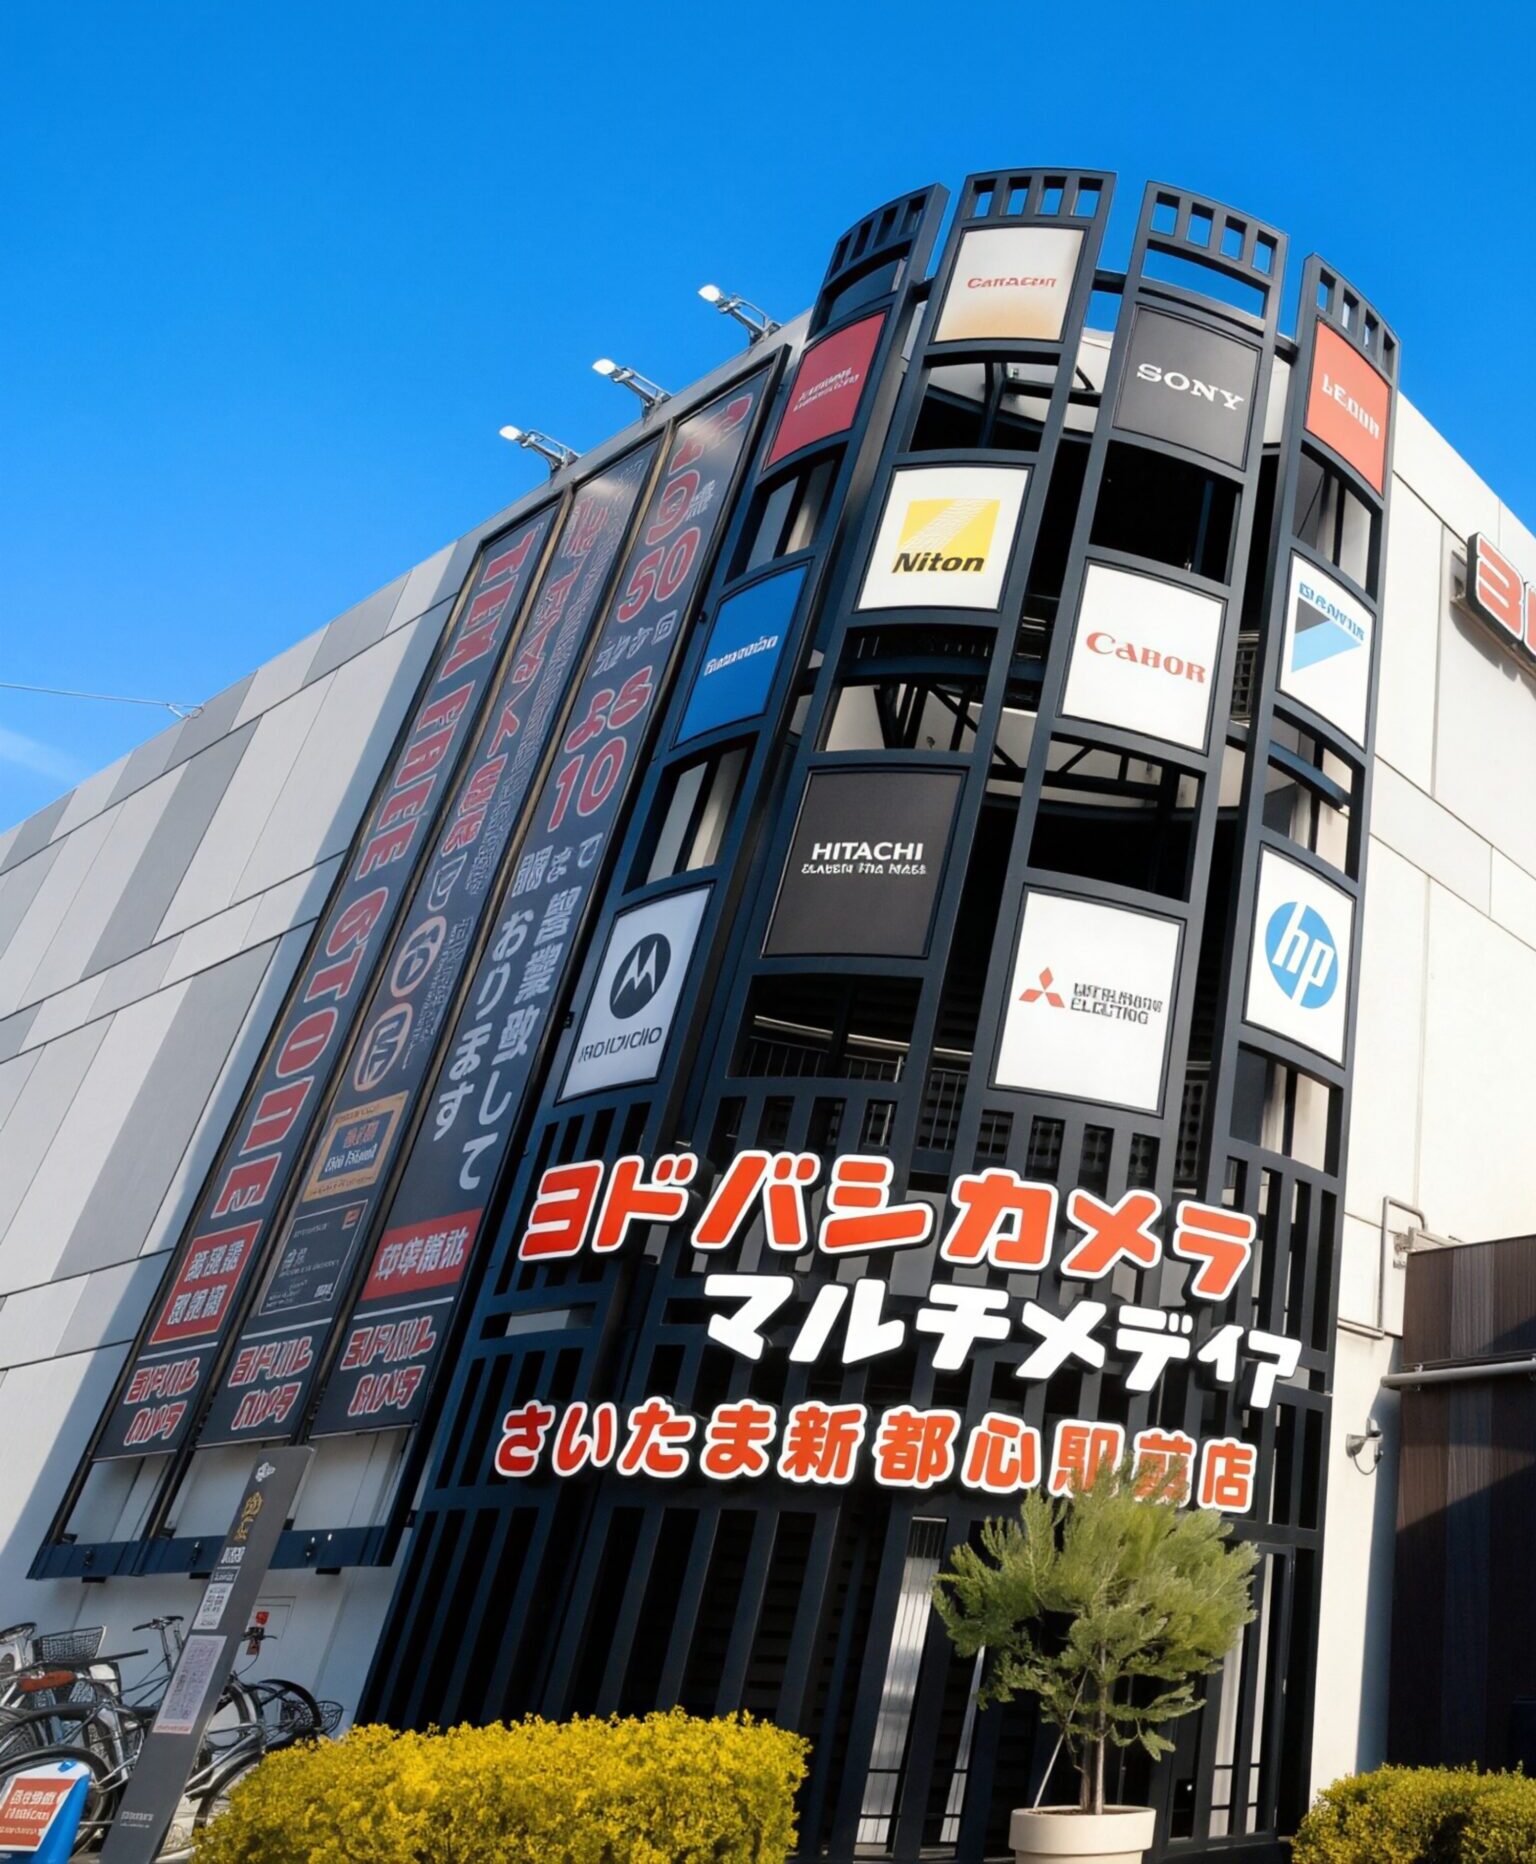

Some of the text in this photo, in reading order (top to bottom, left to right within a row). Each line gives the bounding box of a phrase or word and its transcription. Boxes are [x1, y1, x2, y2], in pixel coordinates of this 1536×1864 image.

[1136, 362, 1244, 412] SONY
[617, 527, 700, 621] 50
[547, 736, 628, 833] 10
[811, 841, 924, 862] HITACHI
[1271, 901, 1336, 1008] hp
[518, 1150, 1257, 1303] ヨドバシカメラ
[703, 1273, 1303, 1410] マルチメディア
